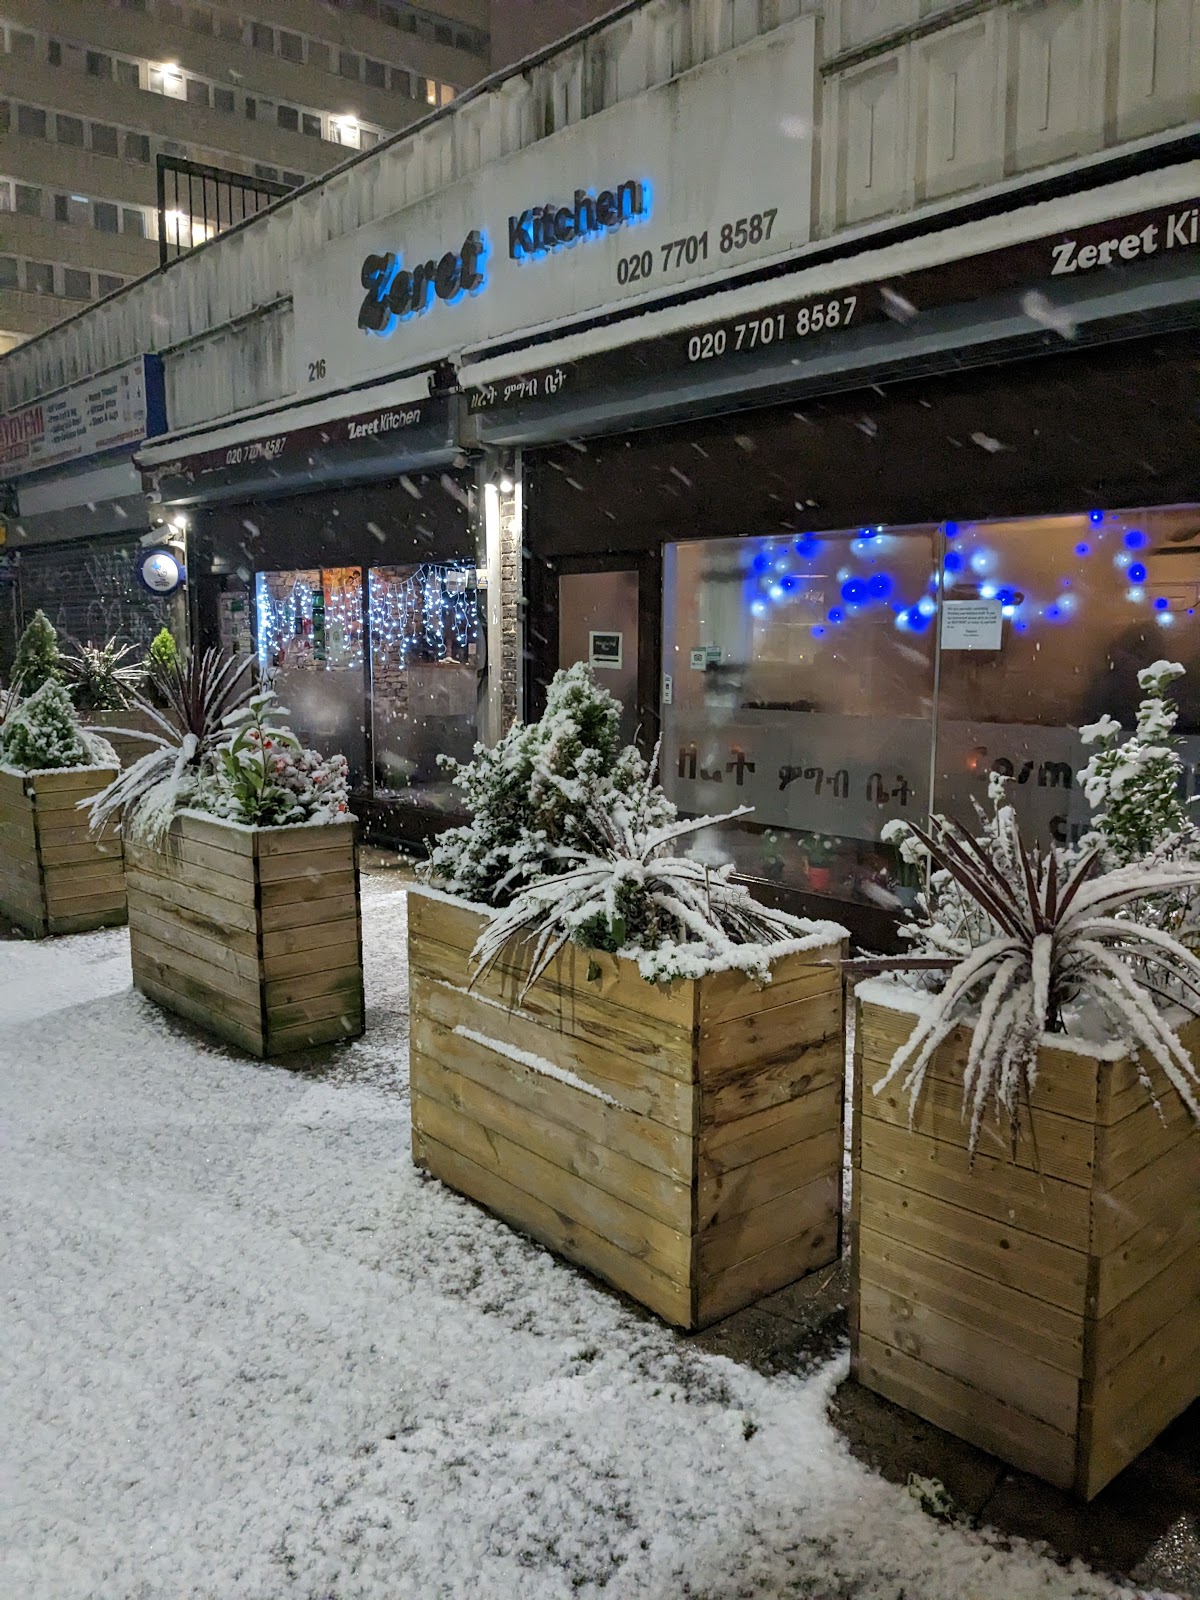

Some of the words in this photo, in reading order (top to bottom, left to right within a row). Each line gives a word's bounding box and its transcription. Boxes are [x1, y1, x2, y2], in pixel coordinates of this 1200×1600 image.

[358, 230, 485, 332] Zeret
[508, 180, 644, 260] Kitchen
[617, 250, 652, 286] 020
[661, 230, 709, 273] 7701
[719, 208, 778, 255] 8587
[1051, 223, 1159, 275] Zeret
[688, 329, 727, 362] 020
[734, 314, 786, 351] 7701
[796, 295, 857, 336] 8587
[308, 358, 327, 383] 216
[347, 420, 380, 441] Zeret
[380, 409, 421, 433] Kitchen
[225, 447, 243, 465] 020
